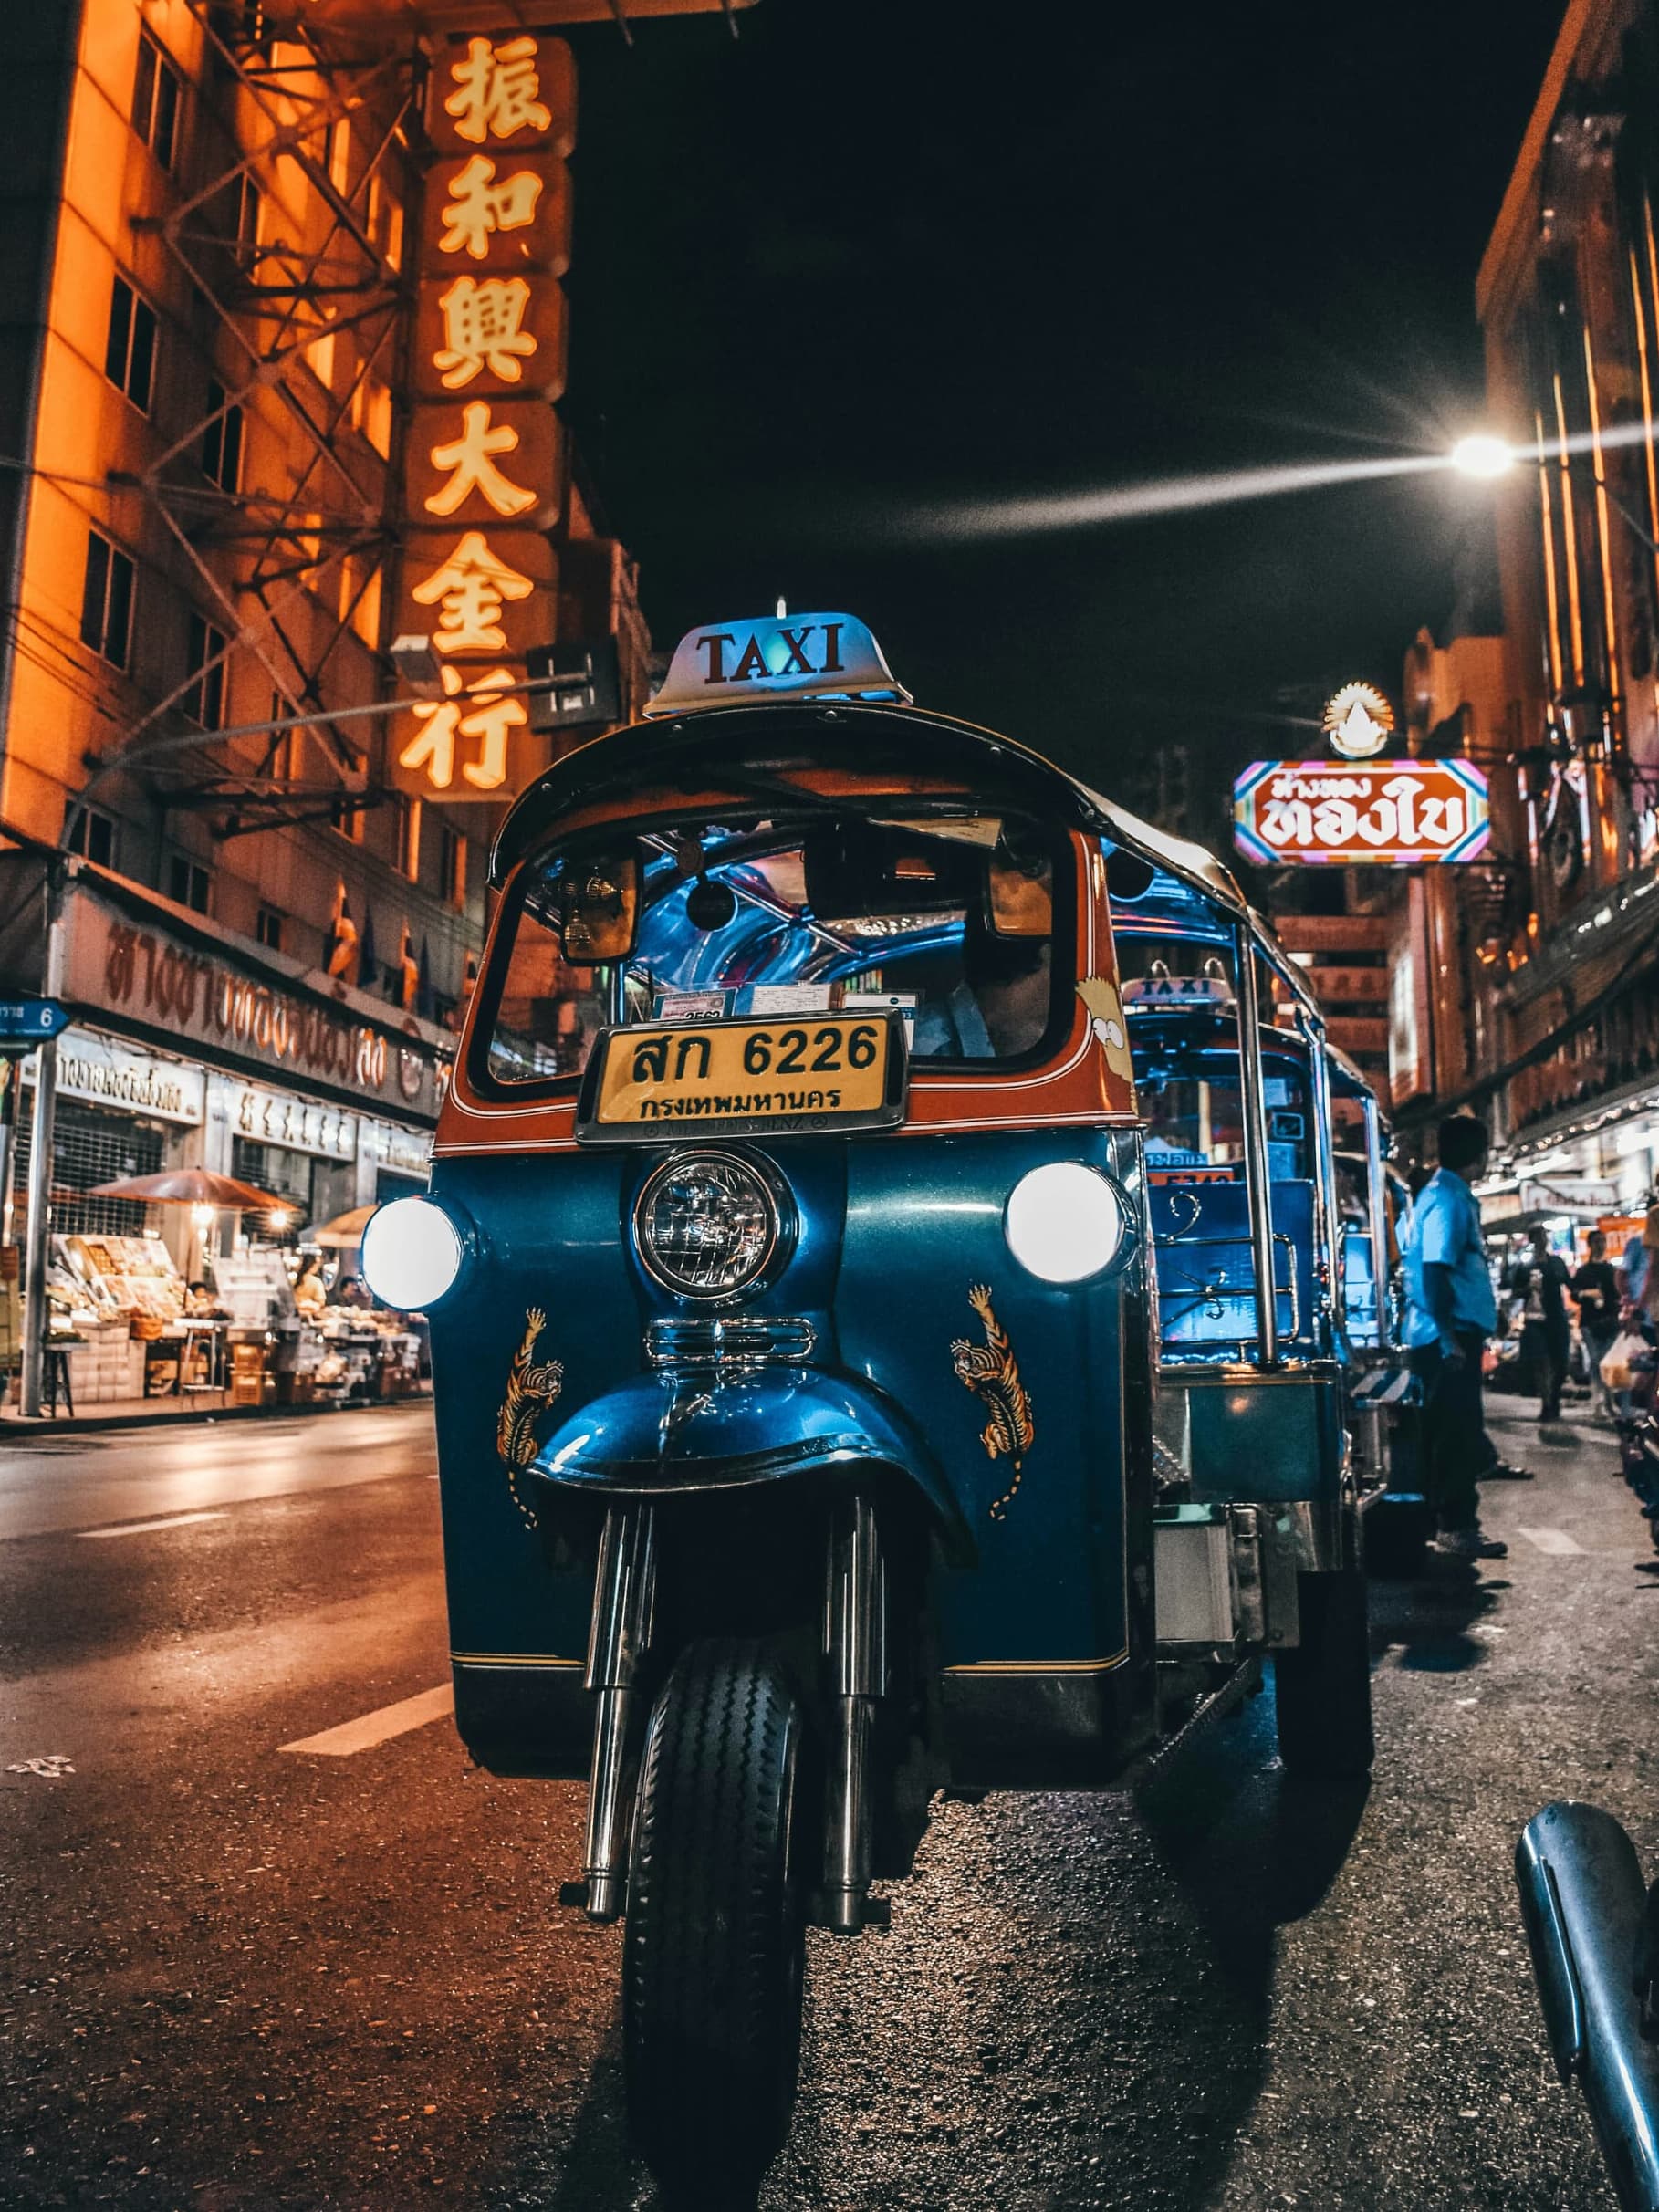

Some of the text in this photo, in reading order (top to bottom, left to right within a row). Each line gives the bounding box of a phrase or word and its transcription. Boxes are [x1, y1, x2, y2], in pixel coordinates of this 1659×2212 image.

[400, 36, 551, 789] 振和興大金行
[695, 622, 845, 685] TAXI
[1259, 776, 1464, 847] ทองใบ
[1141, 979, 1210, 996] TAXI
[39, 1007, 54, 1028] 6
[632, 1025, 878, 1084] สก 6226
[640, 1089, 841, 1120] กรงเทพมหานคร
[659, 1115, 804, 1136] MDES-BENZ
